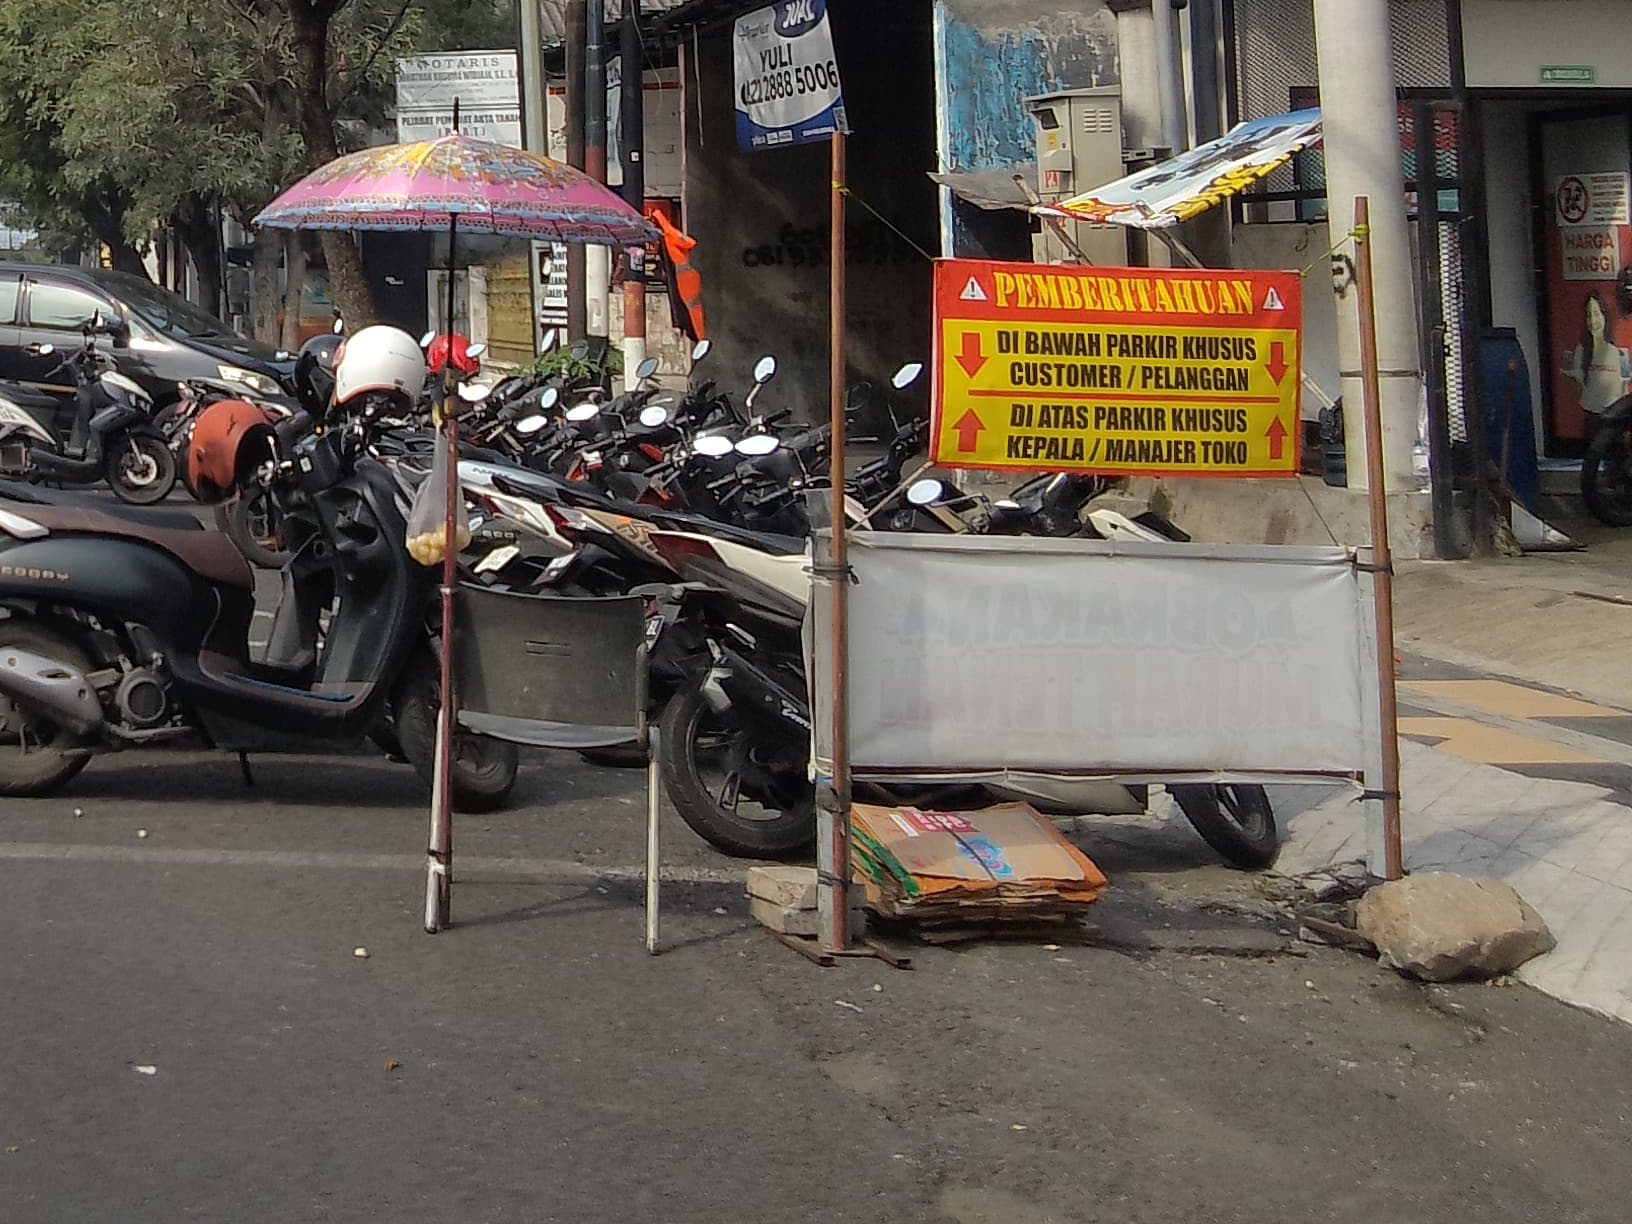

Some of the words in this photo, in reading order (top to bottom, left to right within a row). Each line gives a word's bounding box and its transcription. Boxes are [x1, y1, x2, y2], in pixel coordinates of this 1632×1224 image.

[759, 42, 793, 73] YULI
[1566, 232, 1615, 249] HARGA
[1566, 256, 1616, 272] TINGGI
[992, 272, 1254, 315] PEMBERITAHUAN
[997, 330, 1024, 356] DI
[1025, 331, 1101, 358] BAWAH
[1106, 334, 1179, 360] PARKIR
[1182, 336, 1257, 361] KHUSUS
[1009, 362, 1122, 389] CUSTOMER
[1126, 366, 1137, 389] /
[1140, 365, 1250, 392] PELANGGAN
[1010, 403, 1034, 429] DI
[1037, 404, 1090, 431] ATAS
[1094, 406, 1167, 433] PARKIR
[1171, 408, 1248, 434] KHUSUS
[1007, 435, 1085, 462] KEPALA
[1088, 437, 1102, 463] /
[1105, 438, 1196, 465] MANAJER
[1199, 440, 1248, 466] TOKO
